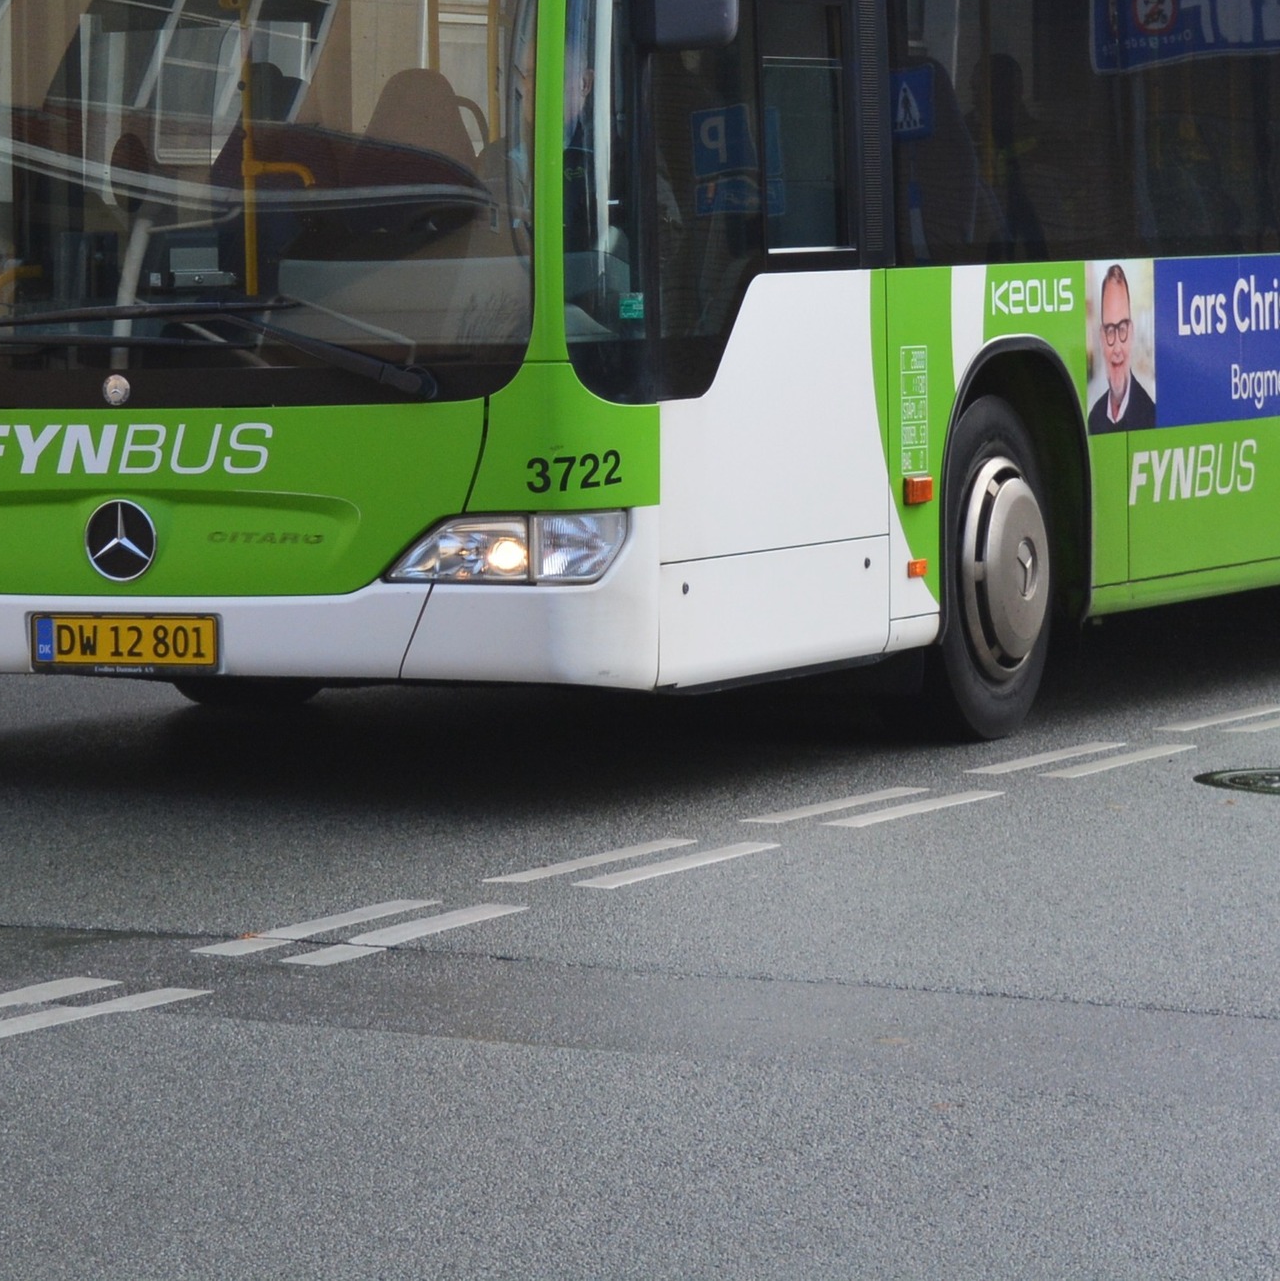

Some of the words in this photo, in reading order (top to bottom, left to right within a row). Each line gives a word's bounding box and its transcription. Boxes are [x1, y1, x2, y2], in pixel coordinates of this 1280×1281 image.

[1177, 280, 1227, 336] Lars
[526, 449, 622, 493] 3722
[1129, 439, 1257, 506] FYNBUS
[39, 644, 52, 655] DK
[57, 624, 97, 656] DW
[110, 625, 143, 657] 12
[152, 625, 206, 659] 801
